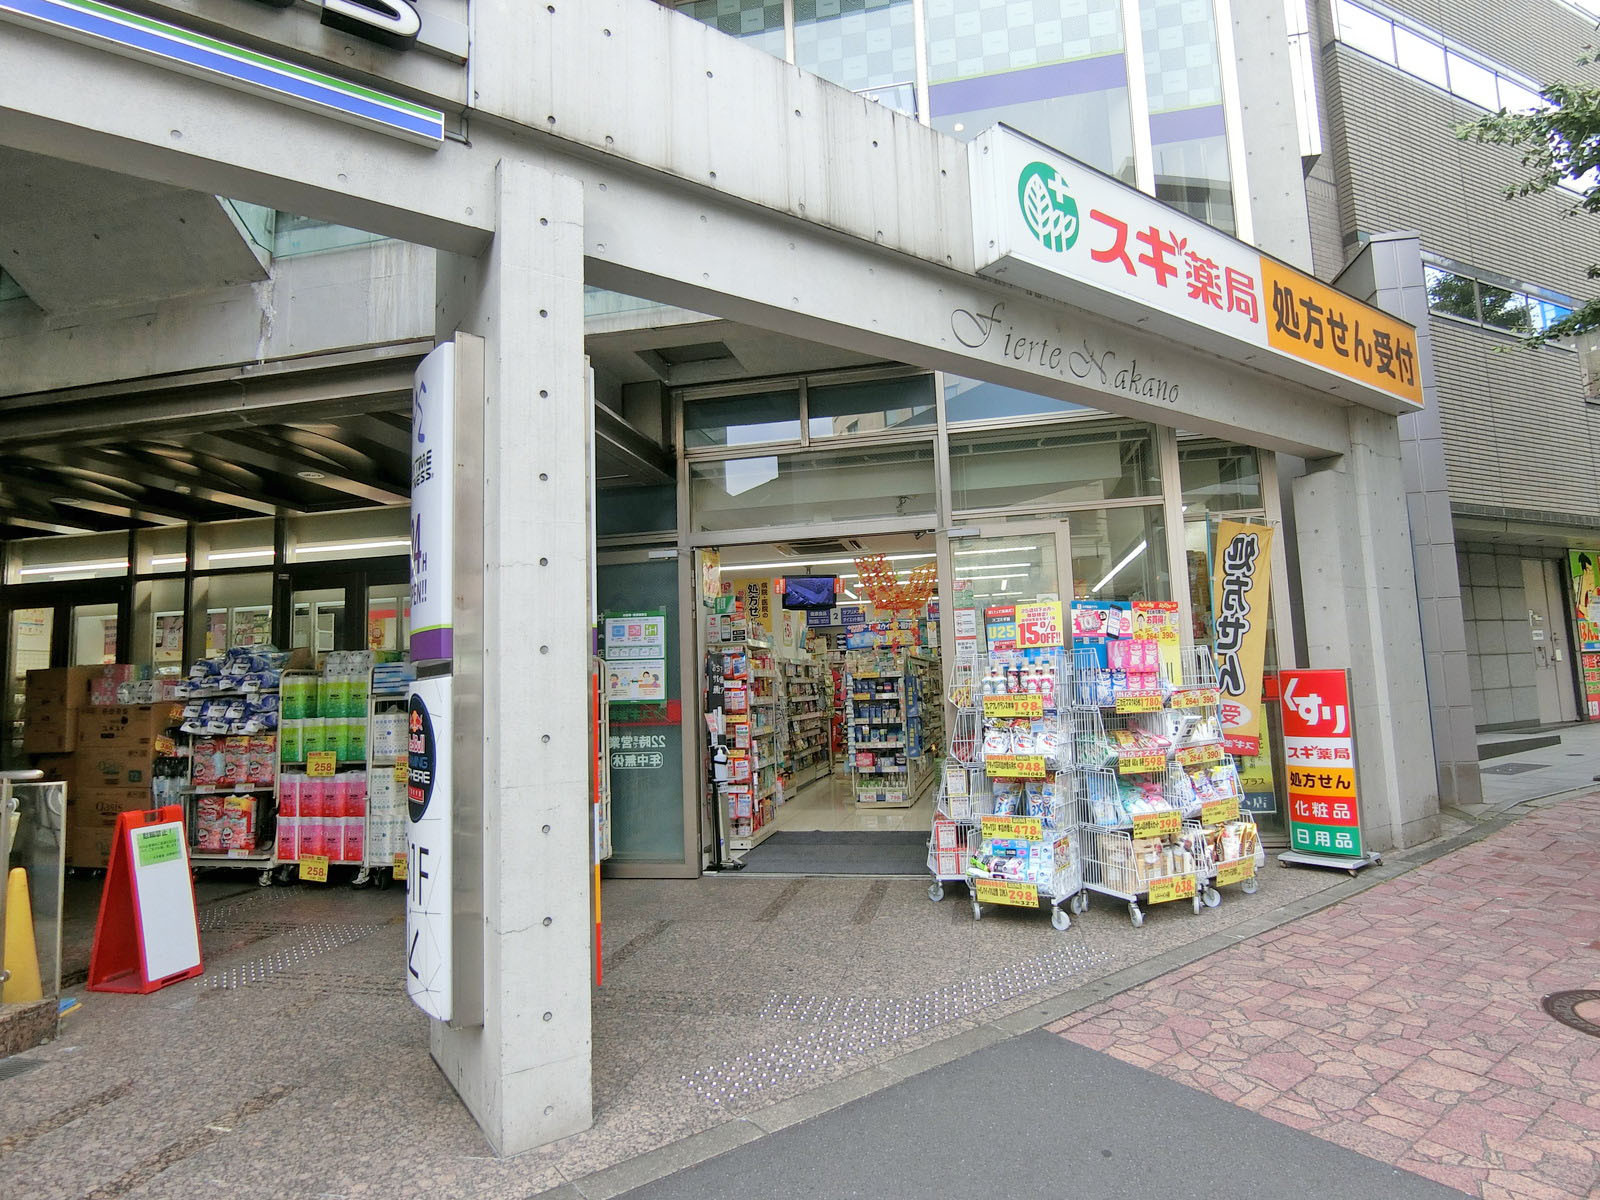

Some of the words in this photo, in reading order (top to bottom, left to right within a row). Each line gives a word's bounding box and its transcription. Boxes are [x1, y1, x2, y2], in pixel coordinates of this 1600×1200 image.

[1089, 207, 1260, 324] スギ薬局
[1272, 279, 1415, 388] 処方せん受付
[1060, 339, 1181, 404] Nakano
[833, 612, 839, 620] 2
[988, 624, 1015, 640] U25
[1014, 702, 1038, 711] 198
[1202, 696, 1213, 704] 390
[1283, 677, 1347, 735] くすり
[1287, 745, 1351, 761] スギ薬局
[314, 763, 332, 772] 258
[1016, 762, 1041, 772] 948
[1143, 757, 1162, 766] 598
[1289, 772, 1351, 790] 処方せん
[1295, 800, 1351, 819] 化粧品
[1013, 825, 1037, 835] 478
[1159, 818, 1177, 830] 398
[1296, 828, 1353, 849] 日用品
[306, 866, 324, 877] 258
[1174, 879, 1193, 893] 638
[1008, 890, 1033, 901] 298
